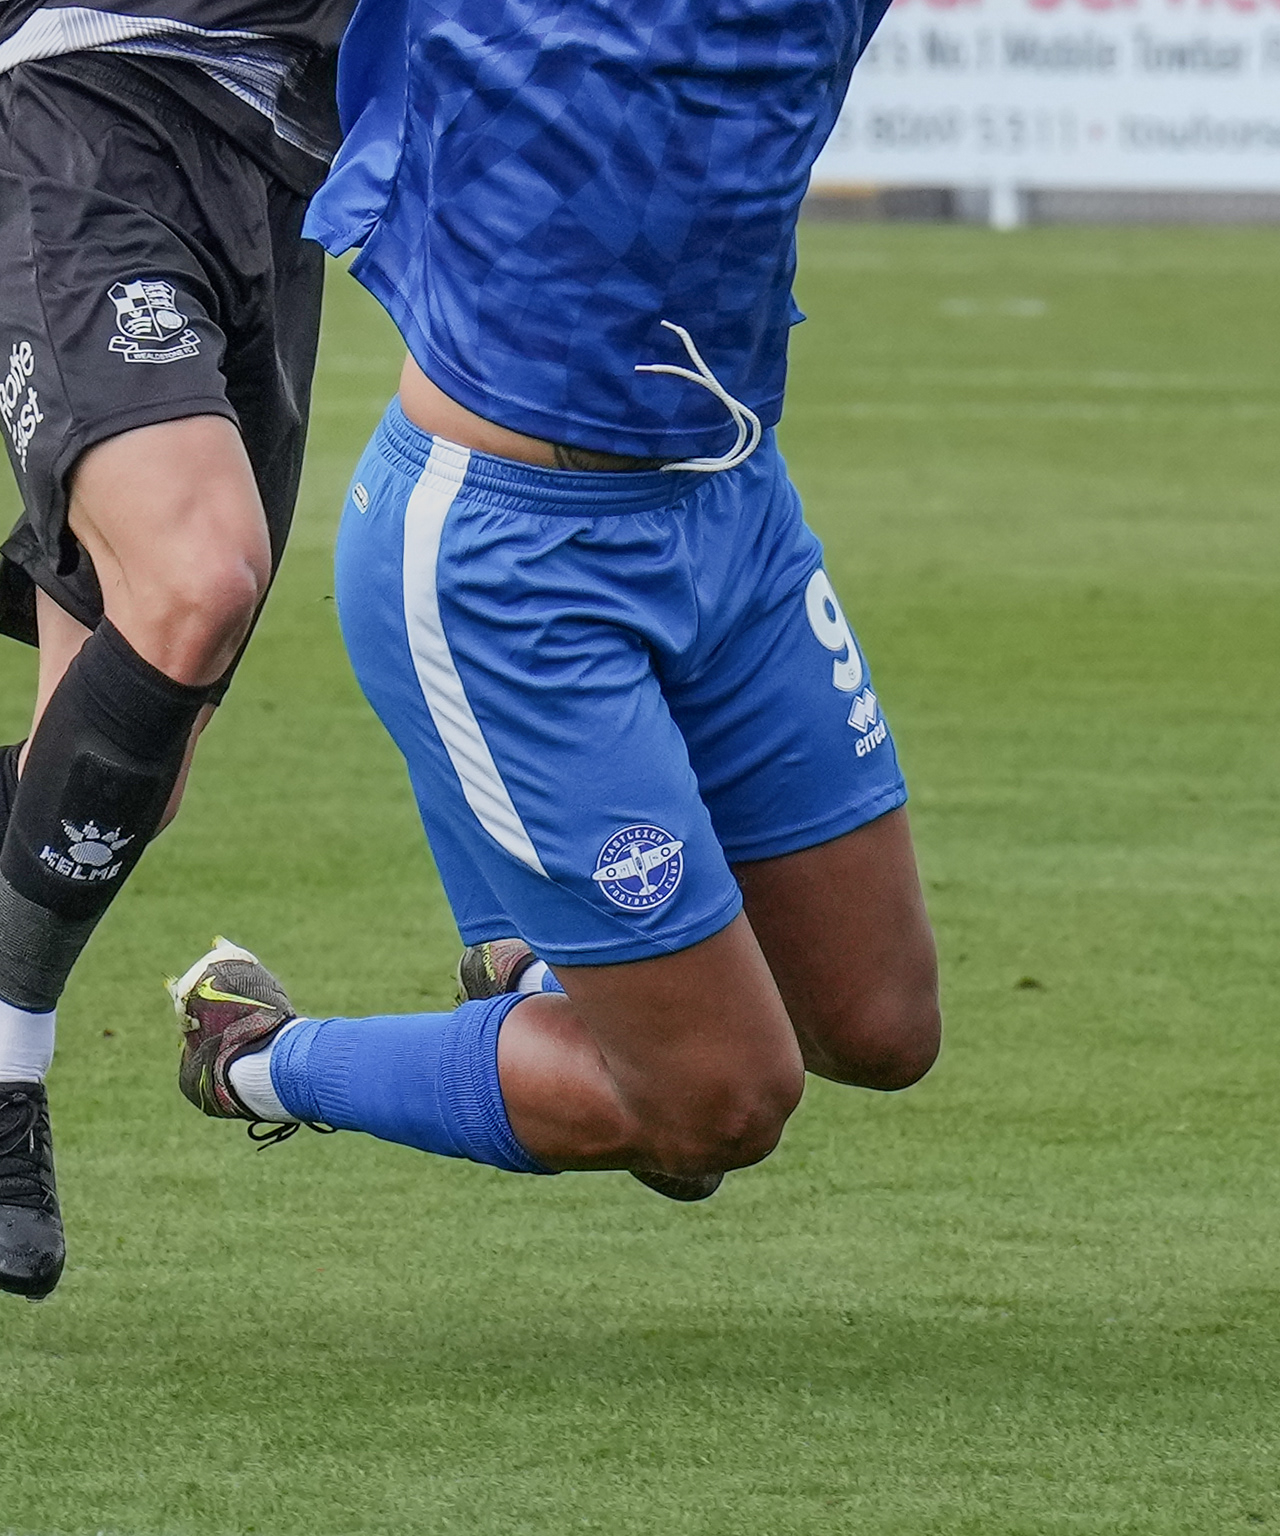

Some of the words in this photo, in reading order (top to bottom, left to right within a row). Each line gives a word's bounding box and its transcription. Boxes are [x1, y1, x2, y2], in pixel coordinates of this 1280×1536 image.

[804, 568, 863, 692] 9
[603, 829, 665, 862] EASTLEIGH
[39, 844, 123, 882] KELME
[665, 861, 678, 889] CLUB
[608, 885, 663, 905] FOOTBALL
